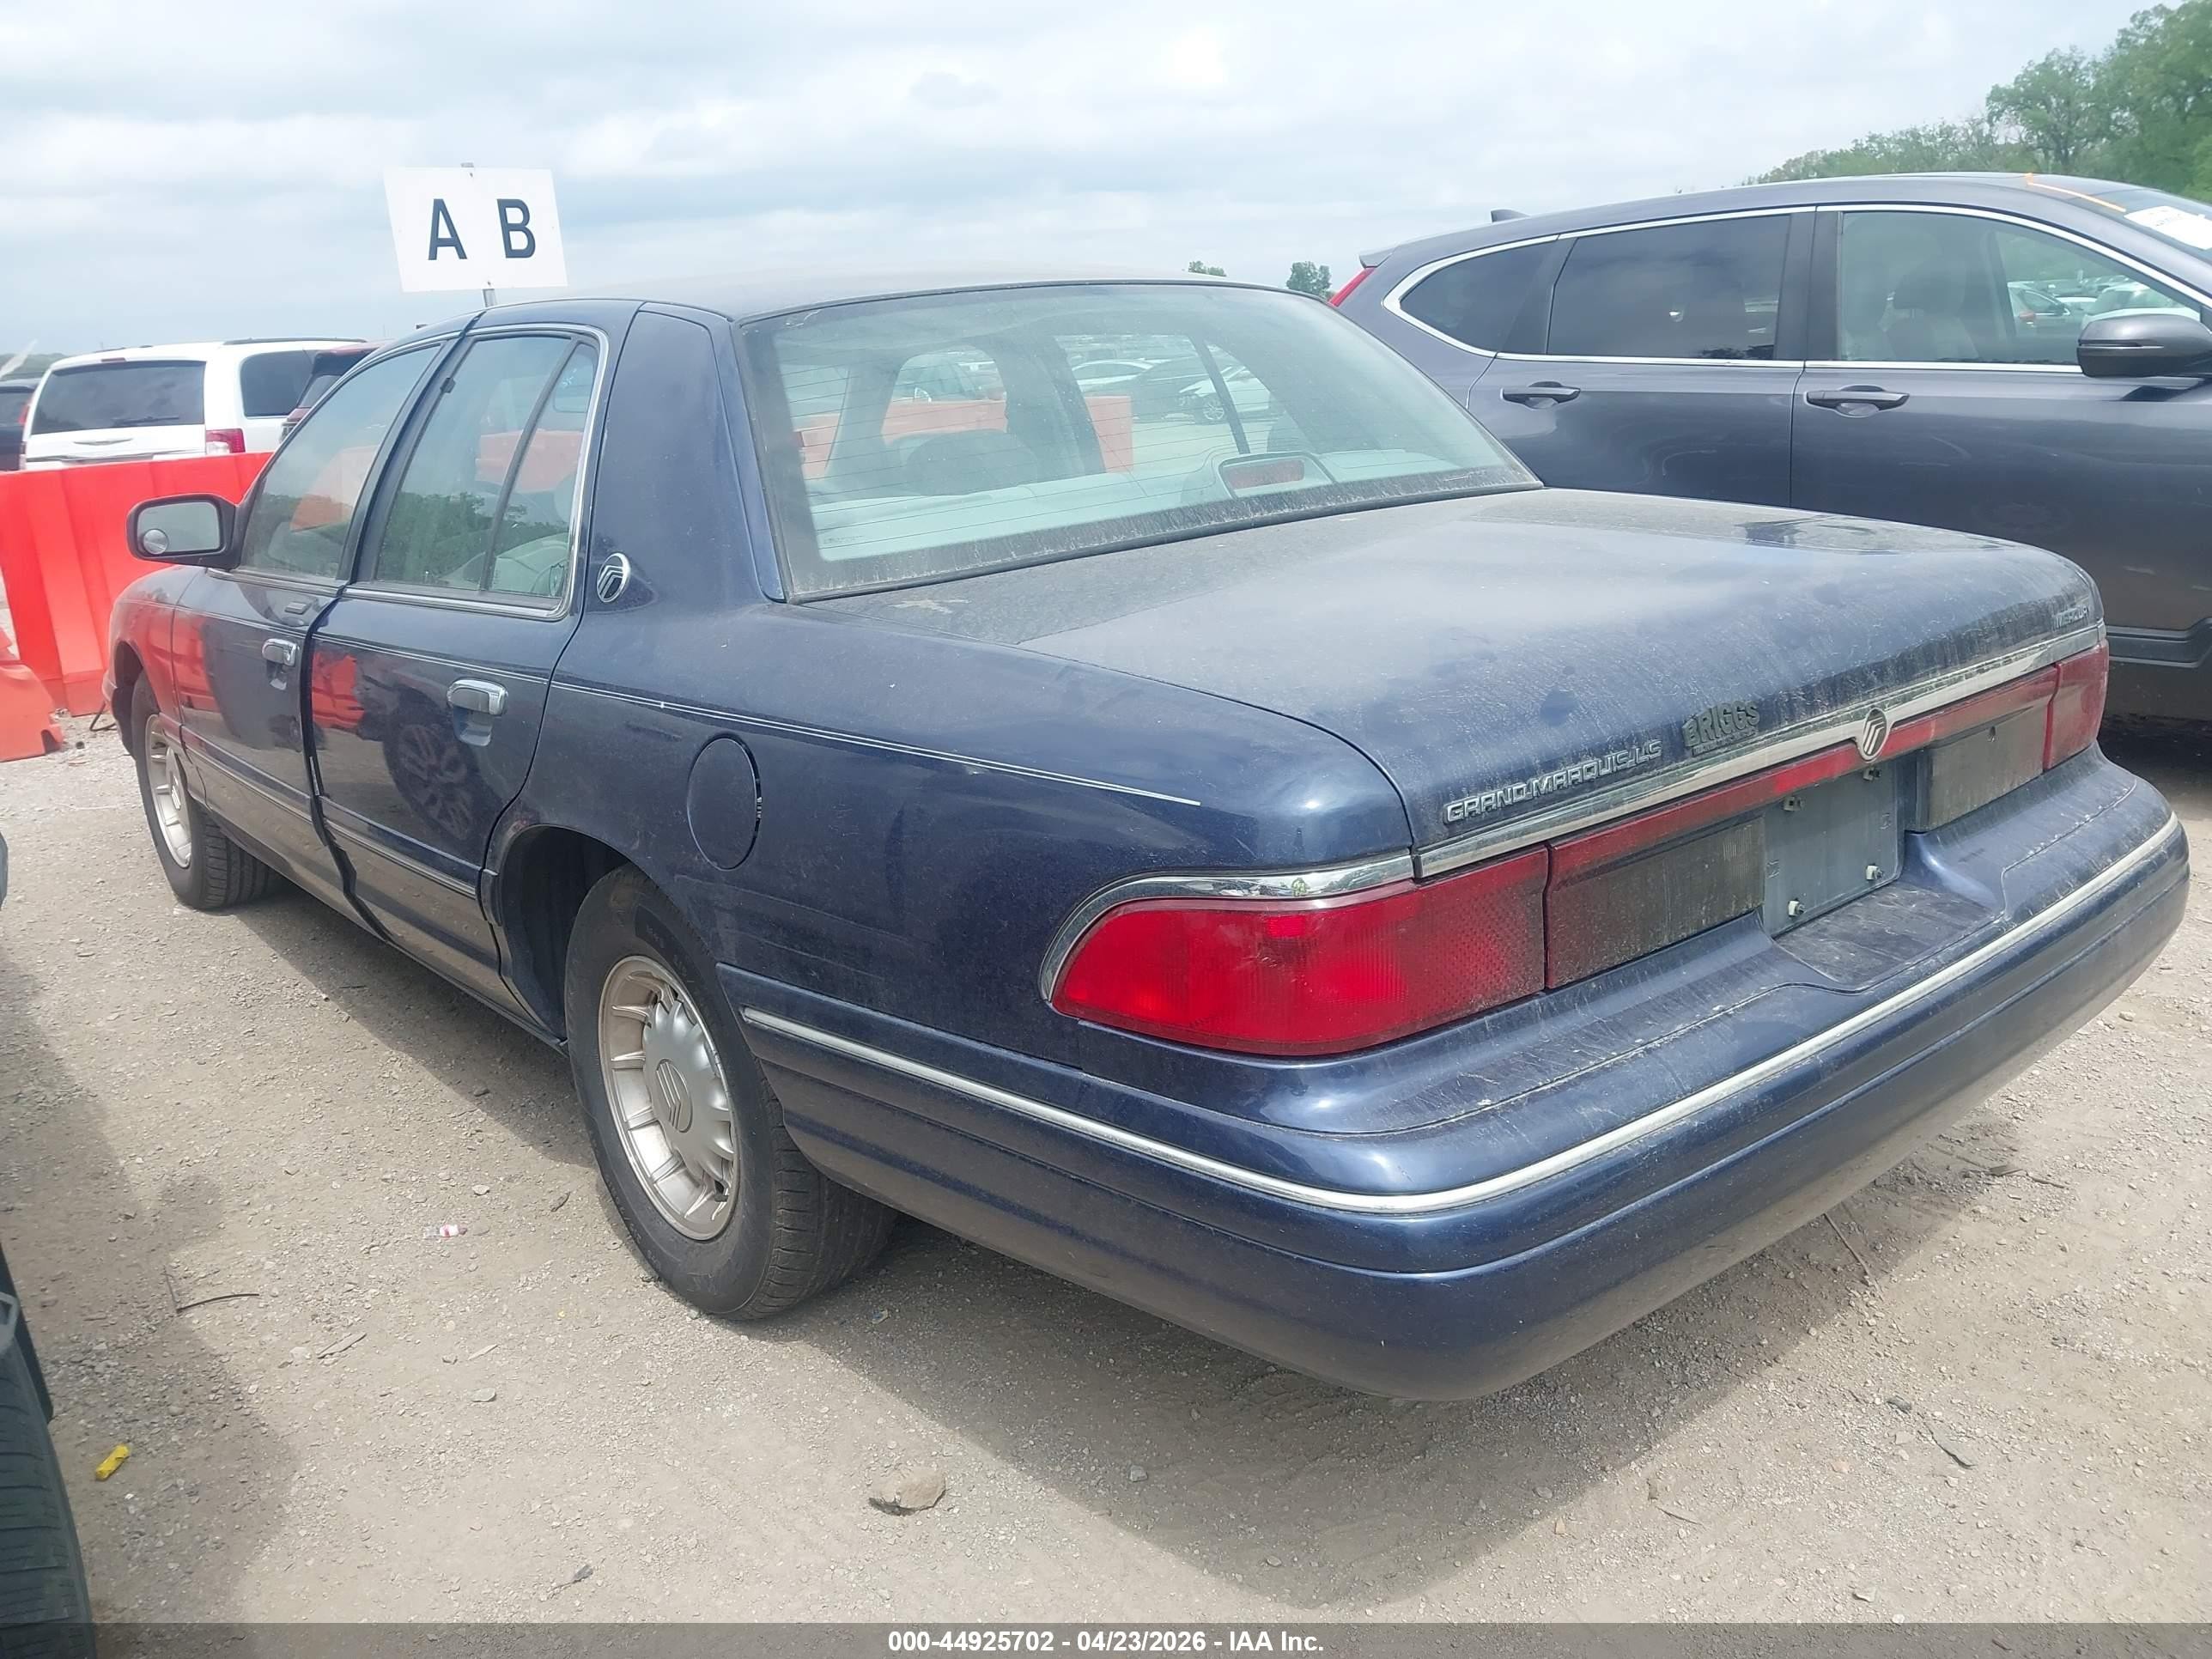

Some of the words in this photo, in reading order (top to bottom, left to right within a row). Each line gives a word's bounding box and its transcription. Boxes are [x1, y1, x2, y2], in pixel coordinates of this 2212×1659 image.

[428, 198, 467, 260] A
[497, 198, 536, 258] B
[2051, 605, 2090, 631] MERCUR
[1682, 700, 1760, 747] BRIGGS
[1443, 782, 1528, 824] GRAND
[1533, 749, 1629, 798] MARQUIS
[1632, 739, 1662, 767] LS
